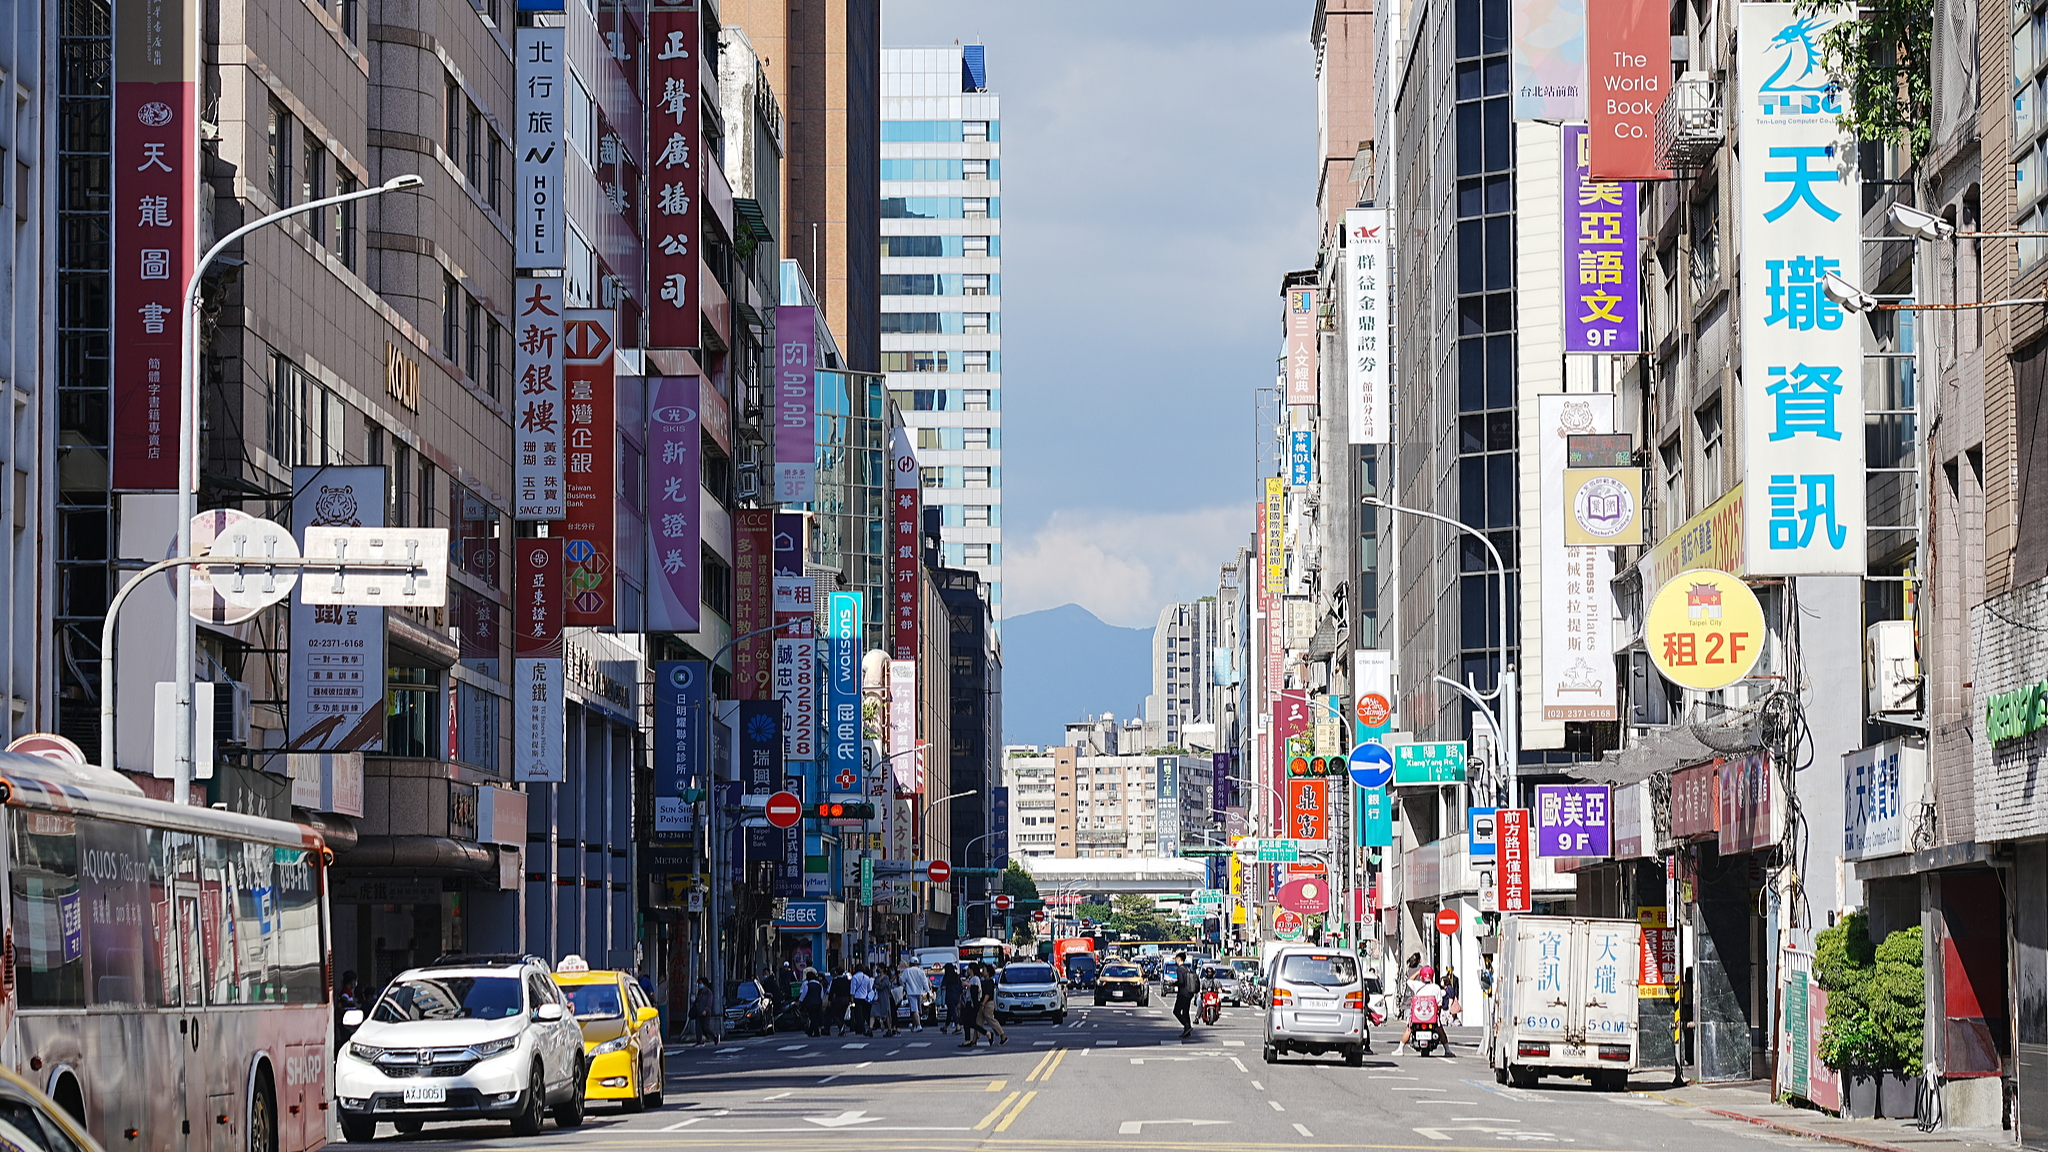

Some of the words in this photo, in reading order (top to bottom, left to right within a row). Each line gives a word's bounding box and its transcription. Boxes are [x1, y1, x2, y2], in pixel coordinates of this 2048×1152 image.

[1613, 52, 1647, 68] The
[528, 41, 553, 134] 北行旅
[1520, 85, 1579, 98] 台北站前館
[1603, 75, 1658, 91] World
[1606, 99, 1653, 115] Book
[1756, 117, 1787, 126] Ten-Long
[1787, 117, 1819, 126] Computer
[1614, 122, 1649, 139] Co.
[656, 31, 692, 310] 正聲廣播公司
[534, 176, 547, 254] HOTEL
[137, 142, 173, 334] 天龍圖書
[1356, 254, 1377, 373] 群益金鼎證券
[1586, 329, 1618, 347] 9F
[1763, 146, 1848, 550] 天瓏資訊
[519, 283, 560, 436] 大新銀樓
[386, 340, 420, 416] KOLIN
[147, 358, 161, 460] 簡體字書籍專賣店
[668, 409, 680, 422] 光
[1362, 381, 1374, 438] 館前分公司
[570, 380, 593, 474] 臺灣企銀
[662, 425, 686, 433] SKIS
[522, 476, 537, 501] 玉石
[566, 492, 597, 500] Business
[566, 500, 585, 508] Bank
[567, 484, 592, 492] Taiwan
[784, 481, 806, 496] 3F
[518, 505, 543, 515] SINCE
[545, 505, 562, 515] 1951
[661, 440, 688, 575] 新光證券
[736, 513, 768, 526] ACC
[567, 522, 596, 531] 台北分行
[898, 494, 914, 584] 華南銀行
[531, 573, 547, 637] 亞東證券
[794, 586, 812, 604] 租
[1566, 546, 1582, 652] 器械彼拉提斯
[1586, 603, 1598, 652] Pilates
[1688, 619, 1708, 627] Taipei
[1709, 619, 1723, 627] City
[308, 639, 364, 648] 02-2371-6168
[840, 608, 851, 683] watsons
[1663, 631, 1698, 667] 租
[1705, 631, 1749, 664] 2F
[531, 662, 547, 703] 虎鐵
[796, 644, 812, 756] 23825228
[1547, 709, 1565, 719] (02)
[1566, 709, 1611, 719] 2371-6168
[660, 805, 677, 813] SUN
[819, 803, 829, 817] 18
[1541, 792, 1606, 828] 歐美亞
[1557, 833, 1590, 850] 9F
[81, 849, 117, 884] AQUOS
[134, 862, 147, 892] pro
[1503, 811, 1523, 910] 前方路口僅准右轉
[1537, 930, 1563, 993] 資訊
[1593, 932, 1619, 995] 天瓏
[1527, 1015, 1561, 1030] 690
[286, 1054, 322, 1087] SHARP
